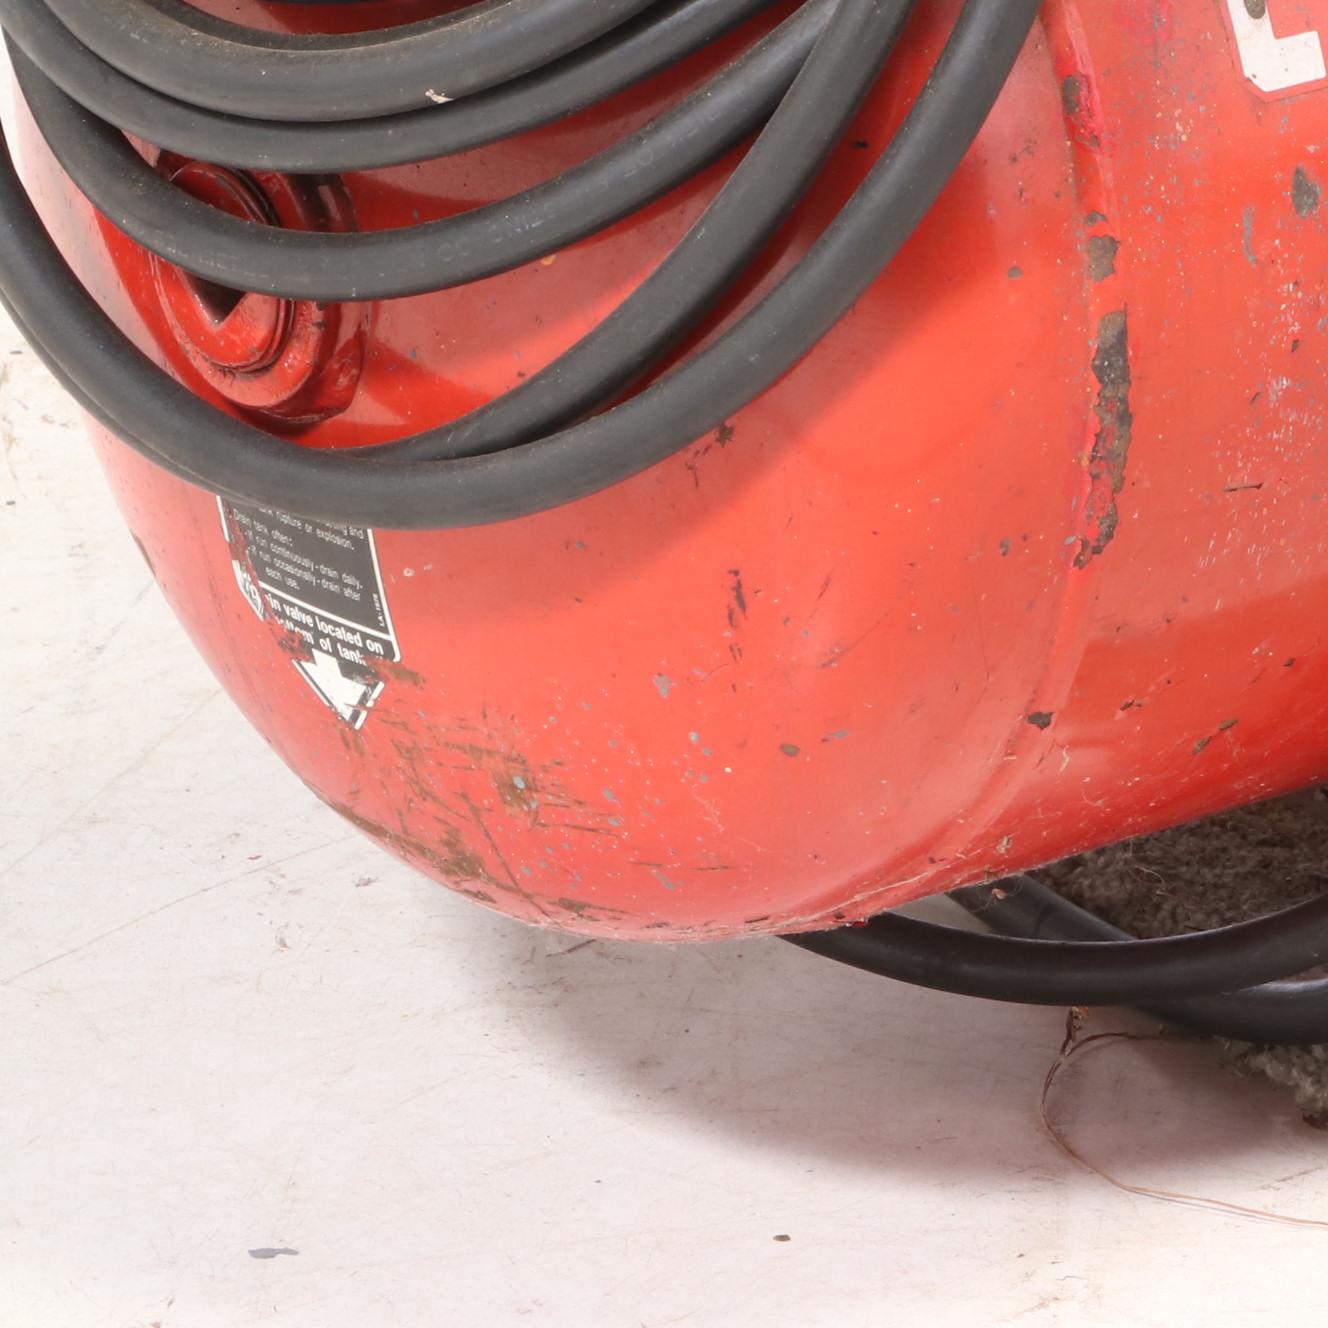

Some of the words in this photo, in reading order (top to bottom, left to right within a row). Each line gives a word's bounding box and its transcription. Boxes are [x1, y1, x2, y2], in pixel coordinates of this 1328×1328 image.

[282, 603, 314, 628] valve
[315, 615, 363, 648] located
[365, 638, 385, 656] on
